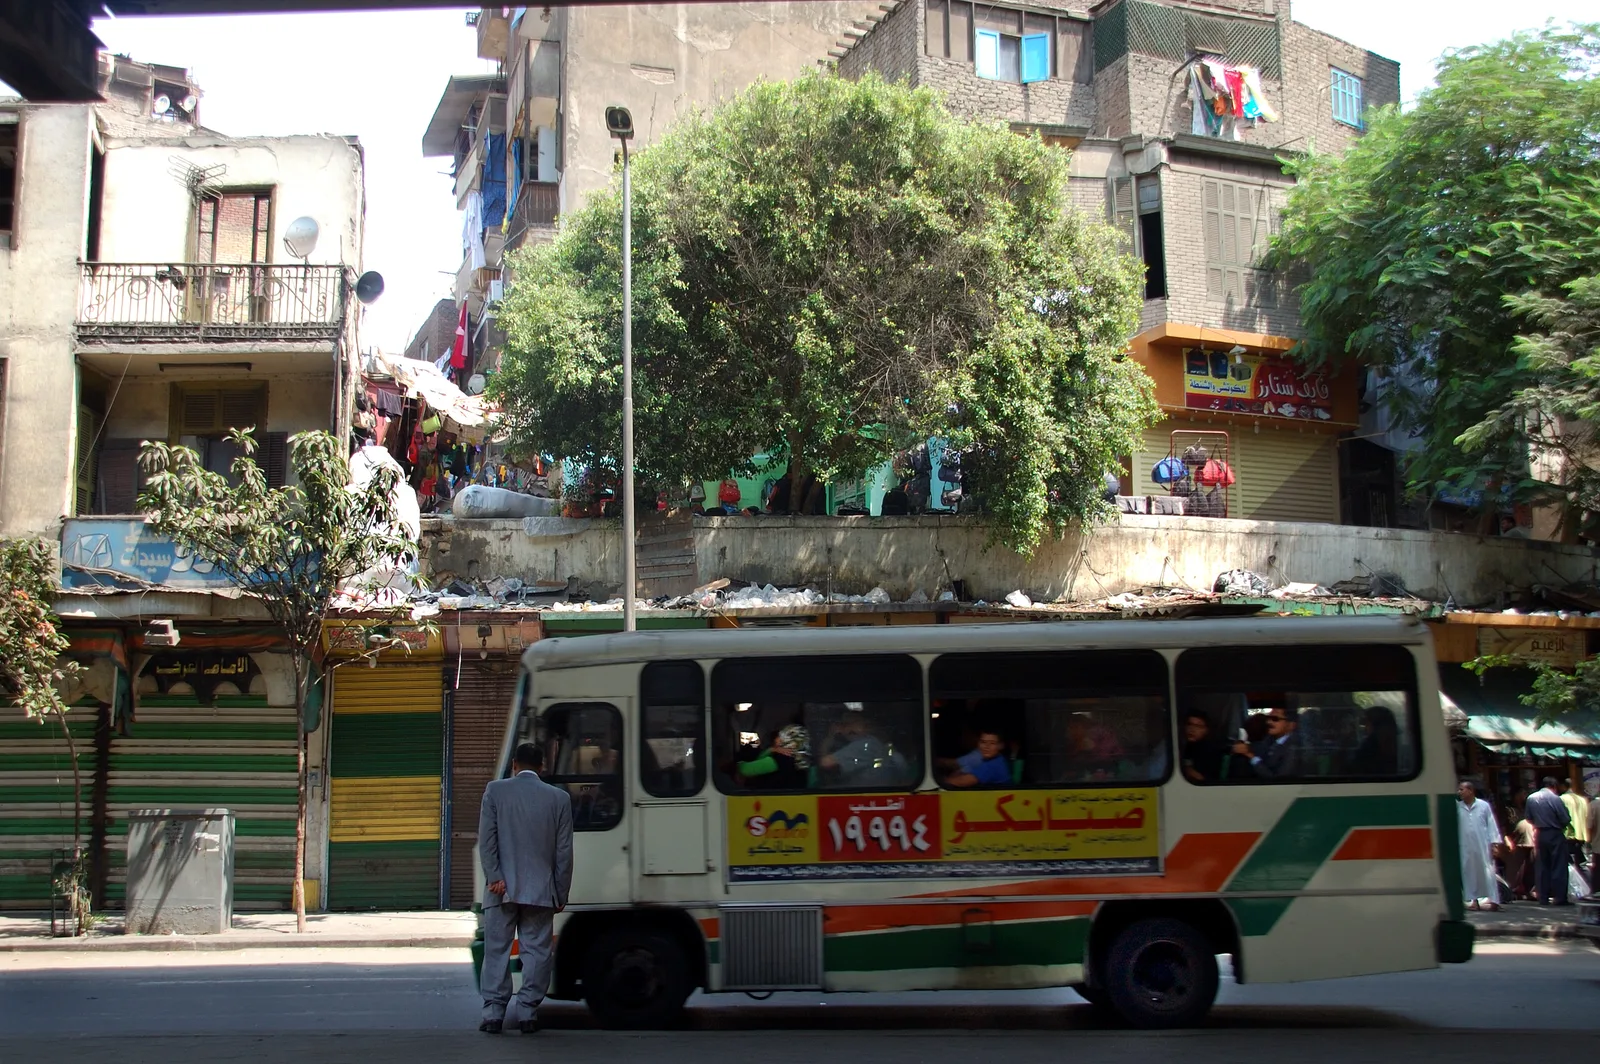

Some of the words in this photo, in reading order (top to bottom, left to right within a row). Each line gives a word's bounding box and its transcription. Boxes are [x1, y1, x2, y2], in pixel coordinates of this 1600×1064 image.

[1257, 371, 1294, 398] ستارز
[120, 547, 172, 574] سيدات
[1530, 637, 1565, 652] الزعيم
[948, 794, 1146, 844] صيانكو
[827, 814, 932, 854] ١٩٩٩٤
